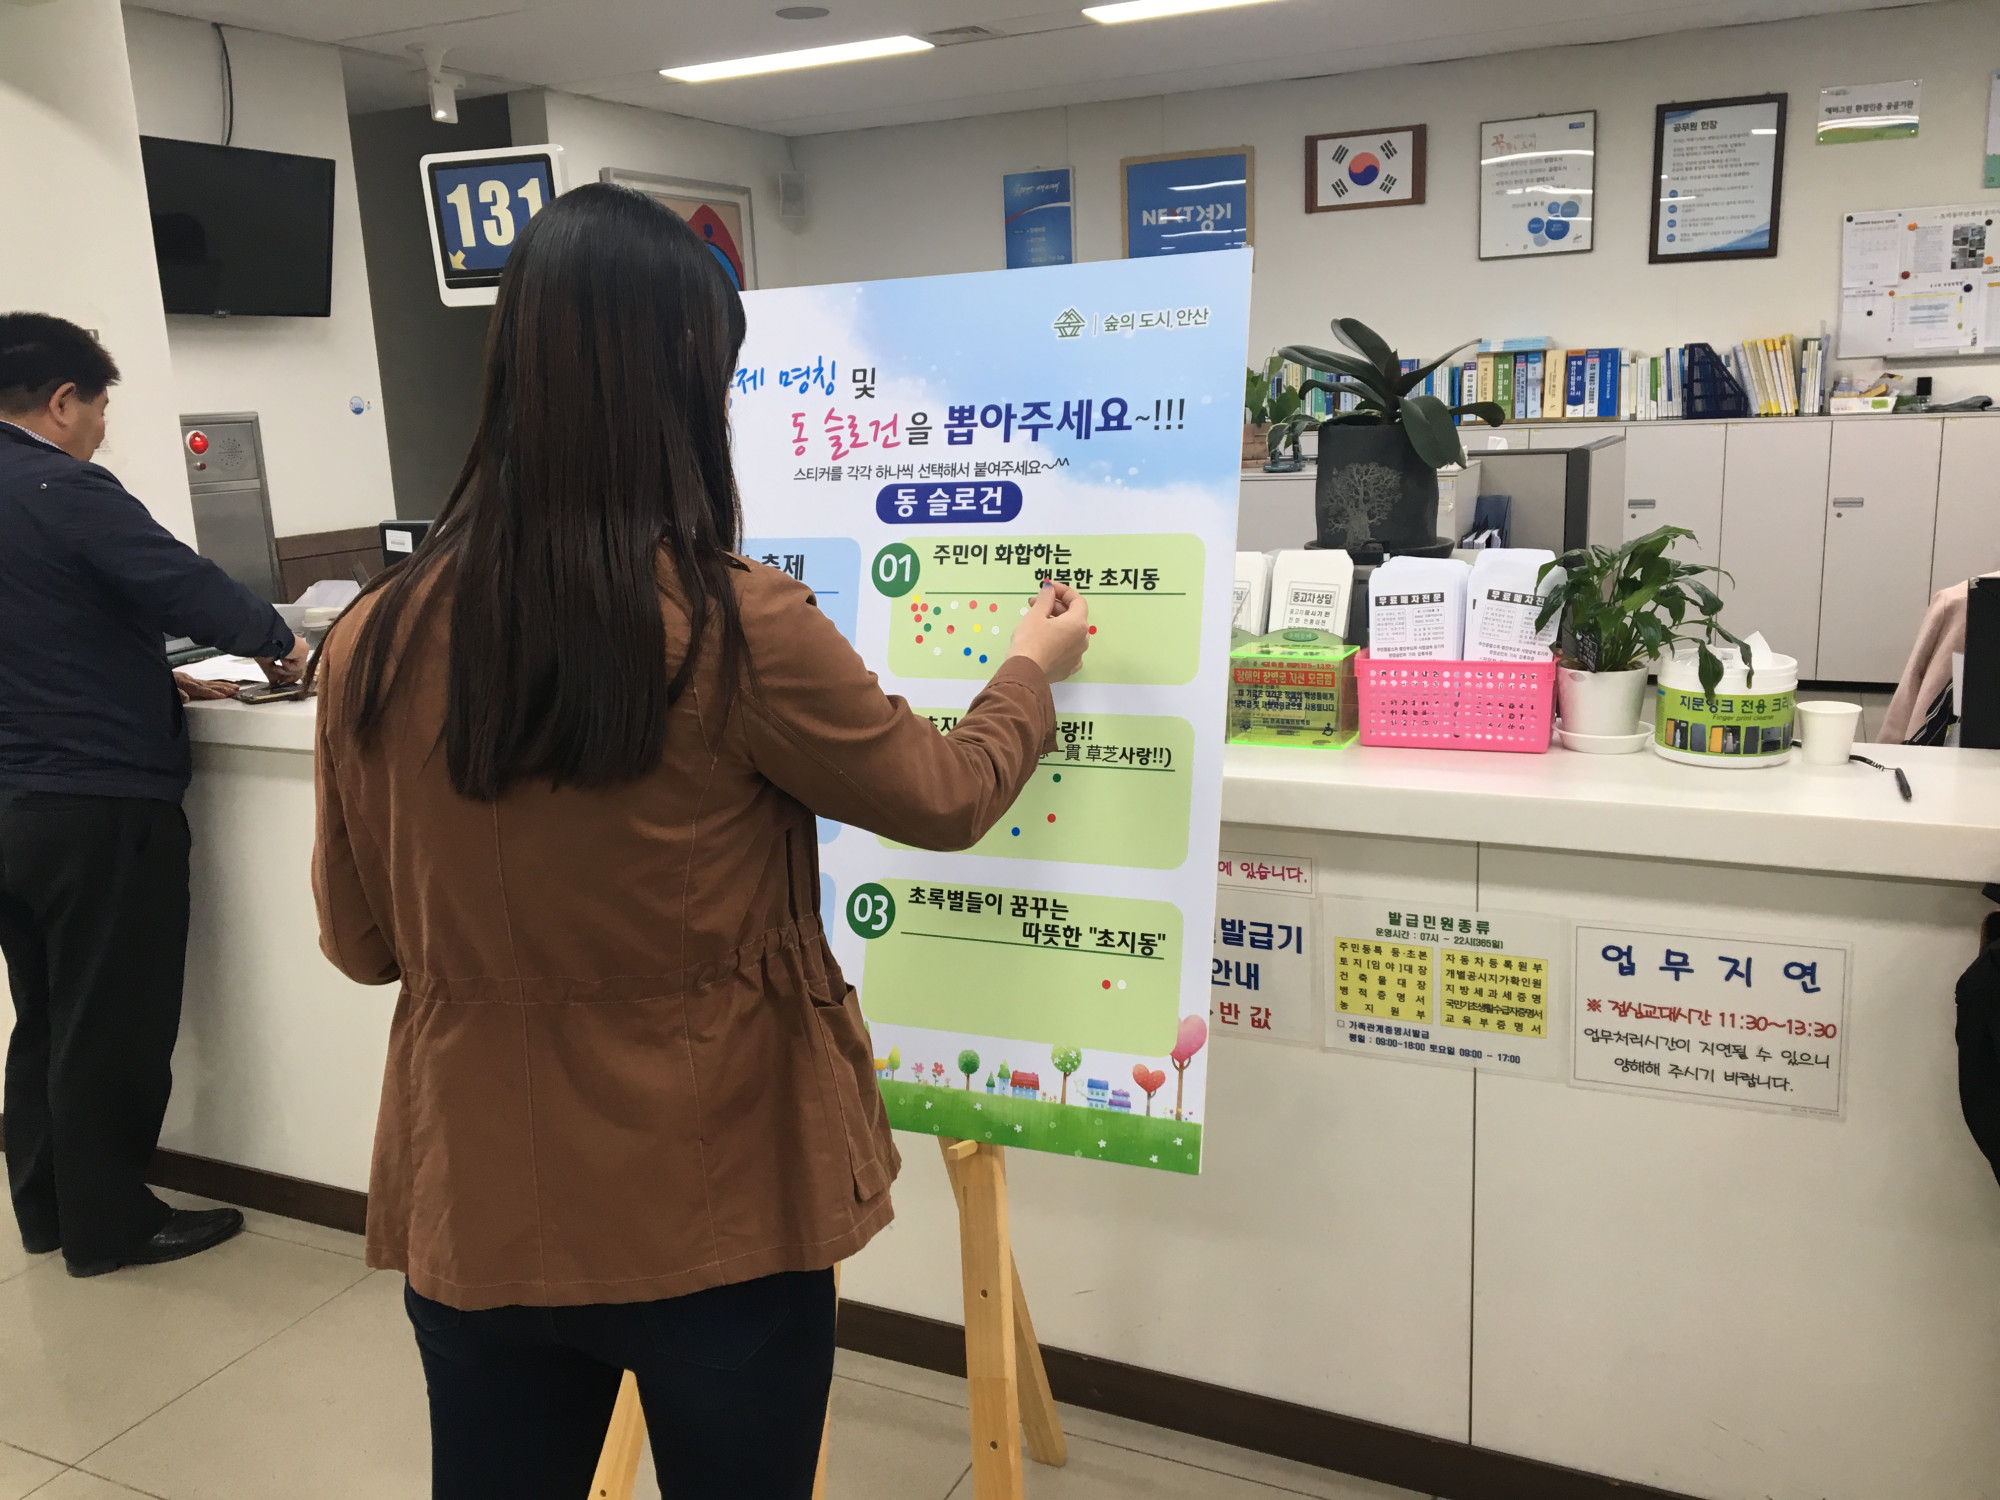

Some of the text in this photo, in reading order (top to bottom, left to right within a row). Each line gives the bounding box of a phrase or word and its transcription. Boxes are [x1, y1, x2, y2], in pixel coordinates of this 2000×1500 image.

[446, 177, 543, 247] 131
[1104, 313, 1134, 332] 숲의
[1177, 307, 1209, 327] 안산
[729, 355, 876, 408] 제 명칭 및
[791, 412, 809, 457] 동
[824, 407, 932, 461] 슬로건을
[793, 465, 843, 482] 스티커를
[847, 464, 872, 481] 각각
[875, 463, 914, 480] 하나씩
[918, 461, 970, 479] 선택해서
[894, 486, 1003, 518] 동 슬로건
[878, 553, 912, 582] 01
[933, 543, 1072, 566] 주민이 화합하는
[1098, 568, 1161, 590] 초지동
[1292, 591, 1333, 605] 중고차상담
[1491, 590, 1545, 606] 무료폐차전
[1680, 695, 1734, 714] 지문잉크
[1741, 699, 1767, 714] 전용
[1055, 721, 1094, 743] 랑!!
[1240, 862, 1307, 883] 있습니다.
[853, 893, 889, 931] 03
[908, 886, 1069, 921] 초록별들이 꿈꾸는
[1214, 918, 1302, 954] 발급기
[1375, 927, 1410, 940] 운영시간
[1420, 933, 1439, 943] 07시
[1388, 911, 1490, 935] 발급민원종류
[1022, 921, 1167, 956] 따뜻한 "초지동"
[1339, 942, 1382, 955] 주민등록
[1212, 958, 1259, 991] 안내
[1349, 1021, 1429, 1039] 가족관계증명서발급
[1608, 1000, 1837, 1039] 점심교대시간 11:30~13:30
[1349, 1033, 1365, 1044] 평일
[1430, 1044, 1455, 1056] 토요일
[1459, 1048, 1482, 1059] 09:00
[1497, 1053, 1521, 1064] 17:00
[1584, 1027, 1829, 1069] 업무처리시간이 지연될 수 있으니
[1614, 1057, 1794, 1092] 양해해 주시기 바랍니다.
